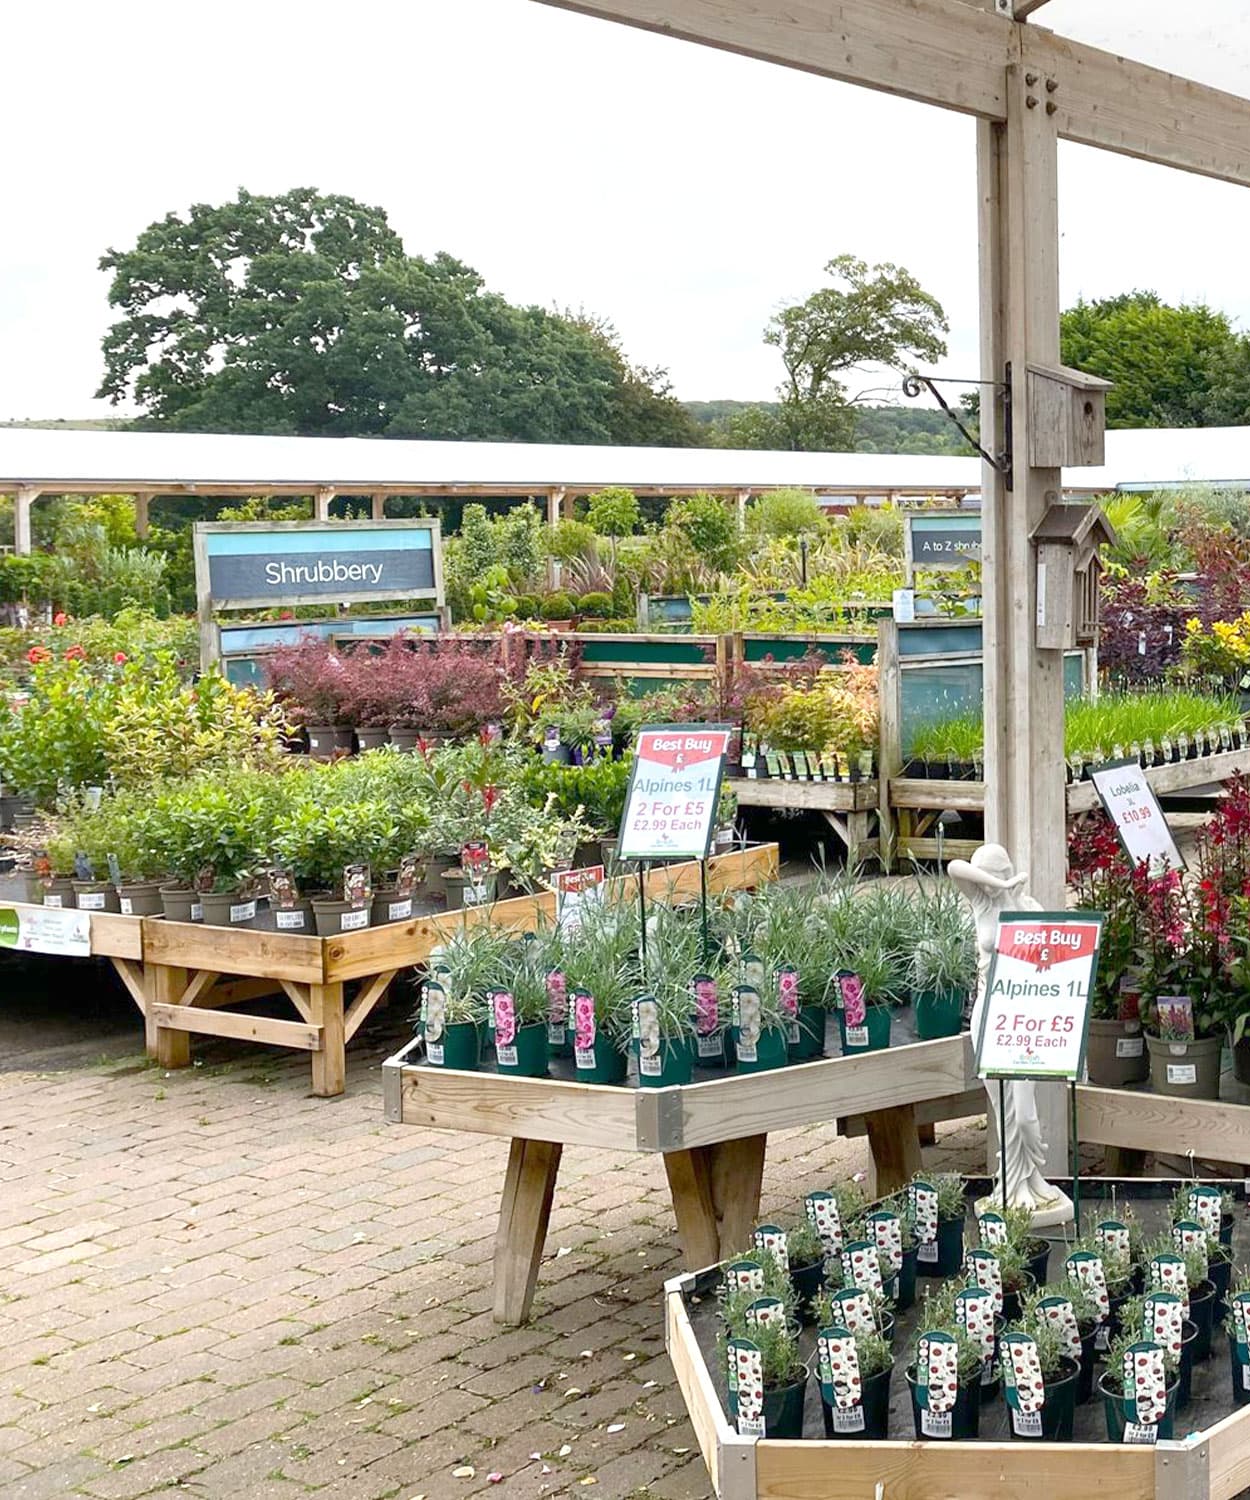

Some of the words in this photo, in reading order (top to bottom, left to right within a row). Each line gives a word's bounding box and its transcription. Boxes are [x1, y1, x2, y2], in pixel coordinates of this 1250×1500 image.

[922, 541, 931, 551] A
[933, 541, 943, 551] to
[945, 541, 952, 551] Z
[265, 560, 383, 585] Shrubbery
[653, 738, 681, 751] Best
[685, 738, 712, 752] Buy
[676, 753, 684, 763] £
[632, 778, 692, 796] Alpines
[698, 777, 715, 791] 1L
[1109, 782, 1140, 797] Lobelia
[636, 802, 647, 816] 2
[652, 802, 680, 816] For
[685, 802, 704, 815] £5
[1122, 806, 1152, 824] £10.99
[633, 820, 667, 830] £2.99
[671, 819, 701, 830] Each
[1013, 930, 1047, 944] Best
[1050, 930, 1081, 949] Buy
[1040, 949, 1049, 960] £
[991, 979, 1060, 1000] Alpines
[1067, 981, 1088, 997] 1L
[995, 1015, 1007, 1030] 2
[1012, 1015, 1046, 1031] For
[1051, 1015, 1074, 1032] £5
[996, 1034, 1031, 1047] £2.99
[1035, 1035, 1067, 1047] Each
